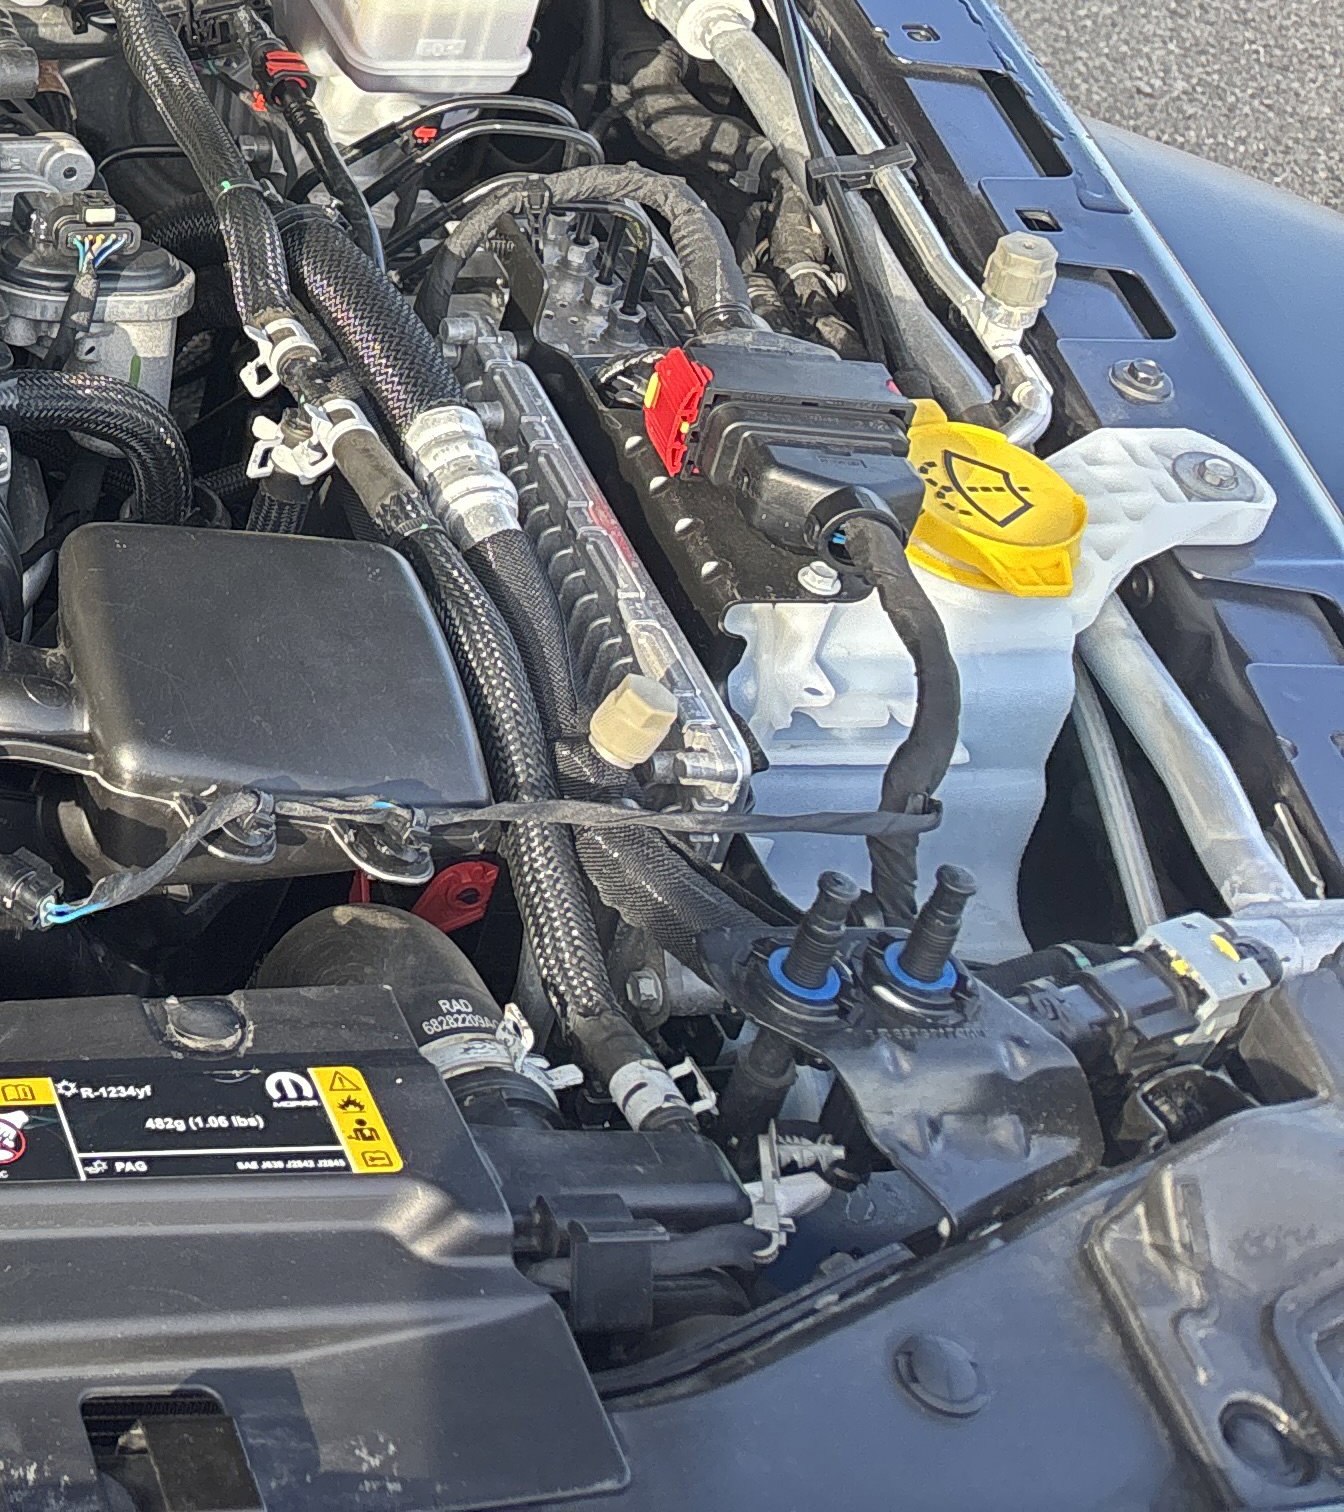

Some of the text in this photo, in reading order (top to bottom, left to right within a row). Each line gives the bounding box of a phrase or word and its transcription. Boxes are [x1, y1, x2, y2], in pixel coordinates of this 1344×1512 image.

[438, 998, 473, 1013] RAD
[79, 1084, 152, 1100] R-1234yf
[144, 1114, 265, 1132] 482g (1.06 lbs)
[114, 1161, 148, 1174] PAG
